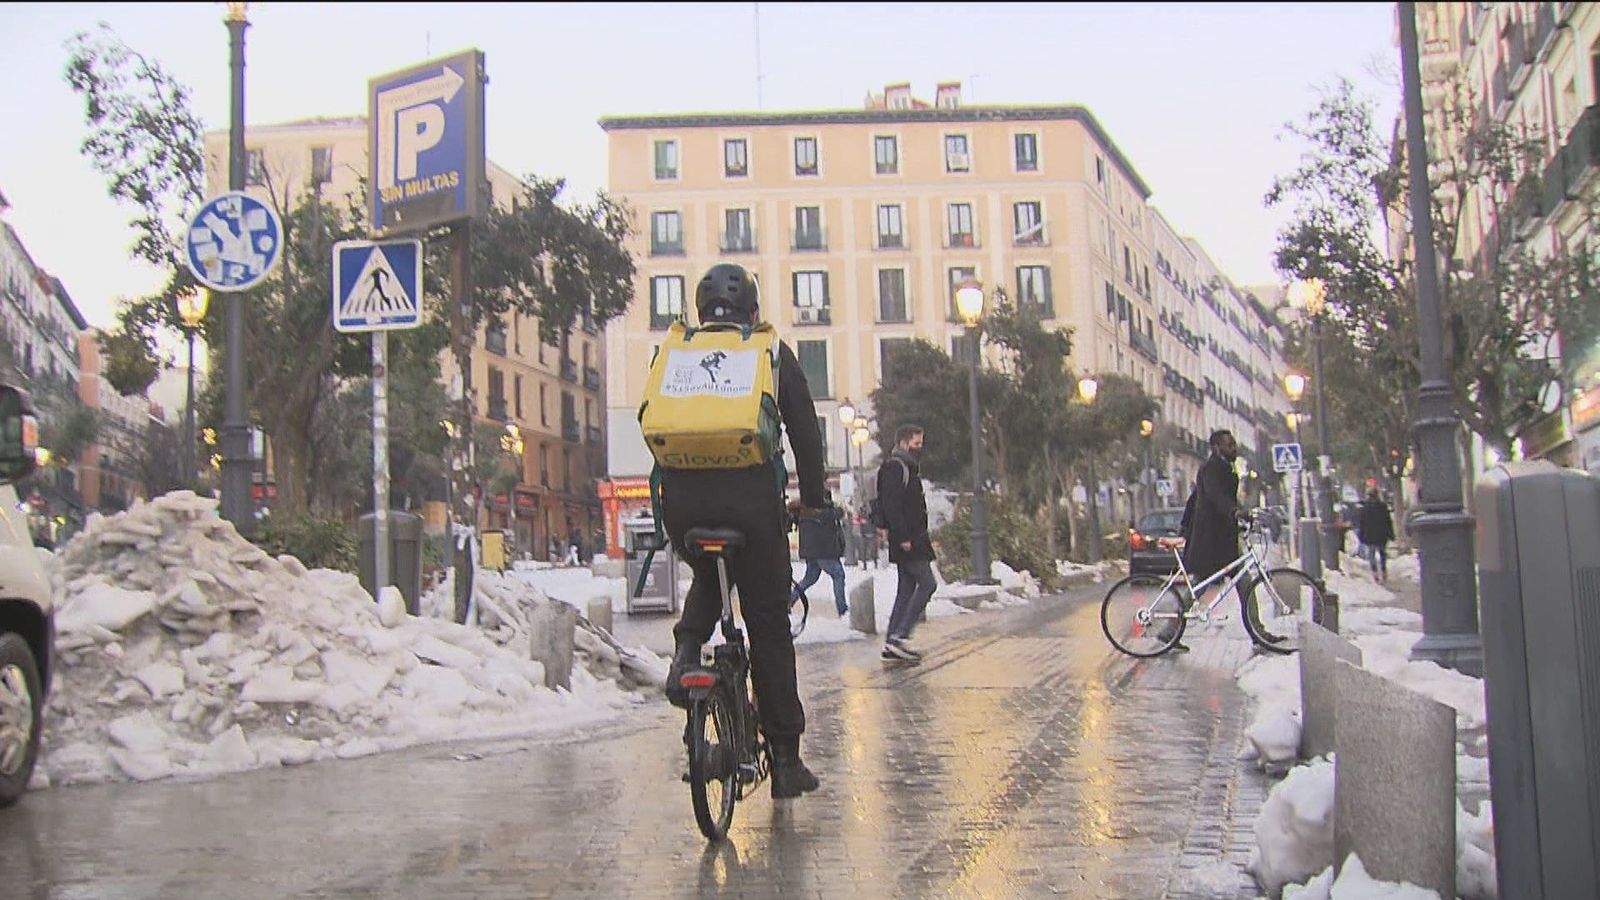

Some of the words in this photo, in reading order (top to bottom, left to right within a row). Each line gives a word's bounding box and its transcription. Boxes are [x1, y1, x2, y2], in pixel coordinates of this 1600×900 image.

[397, 103, 446, 181] P
[381, 184, 404, 203] SIN
[405, 170, 460, 198] MULTAS
[664, 451, 741, 467] Glovo
